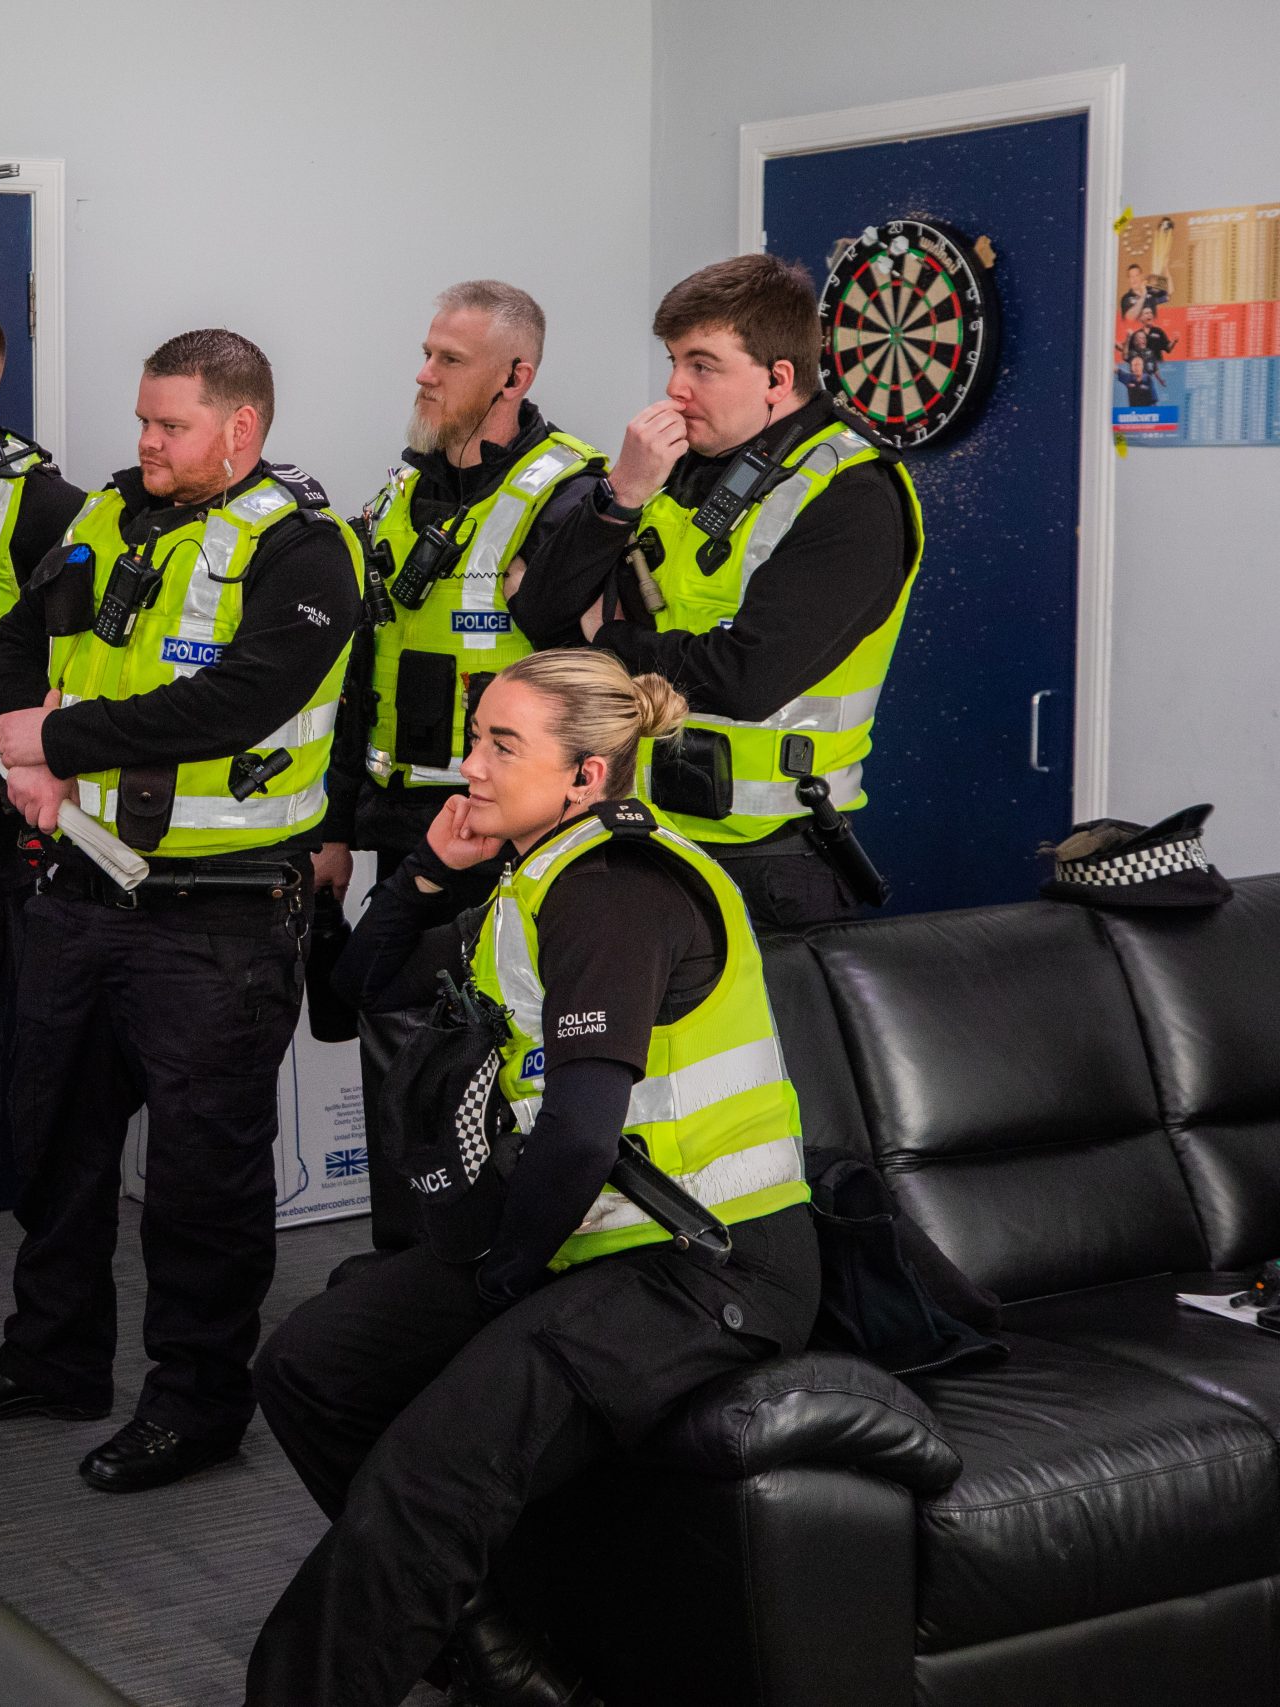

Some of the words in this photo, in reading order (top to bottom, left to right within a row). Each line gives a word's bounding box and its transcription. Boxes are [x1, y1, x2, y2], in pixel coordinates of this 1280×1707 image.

[889, 222, 904, 234] 20
[297, 603, 331, 626] POILEAS
[455, 614, 508, 630] POLICE
[166, 641, 223, 663] POLICE
[615, 813, 645, 821] 538
[558, 1011, 606, 1028] POLICE
[557, 1023, 607, 1039] SCOTLAND
[410, 1168, 452, 1194] LICE
